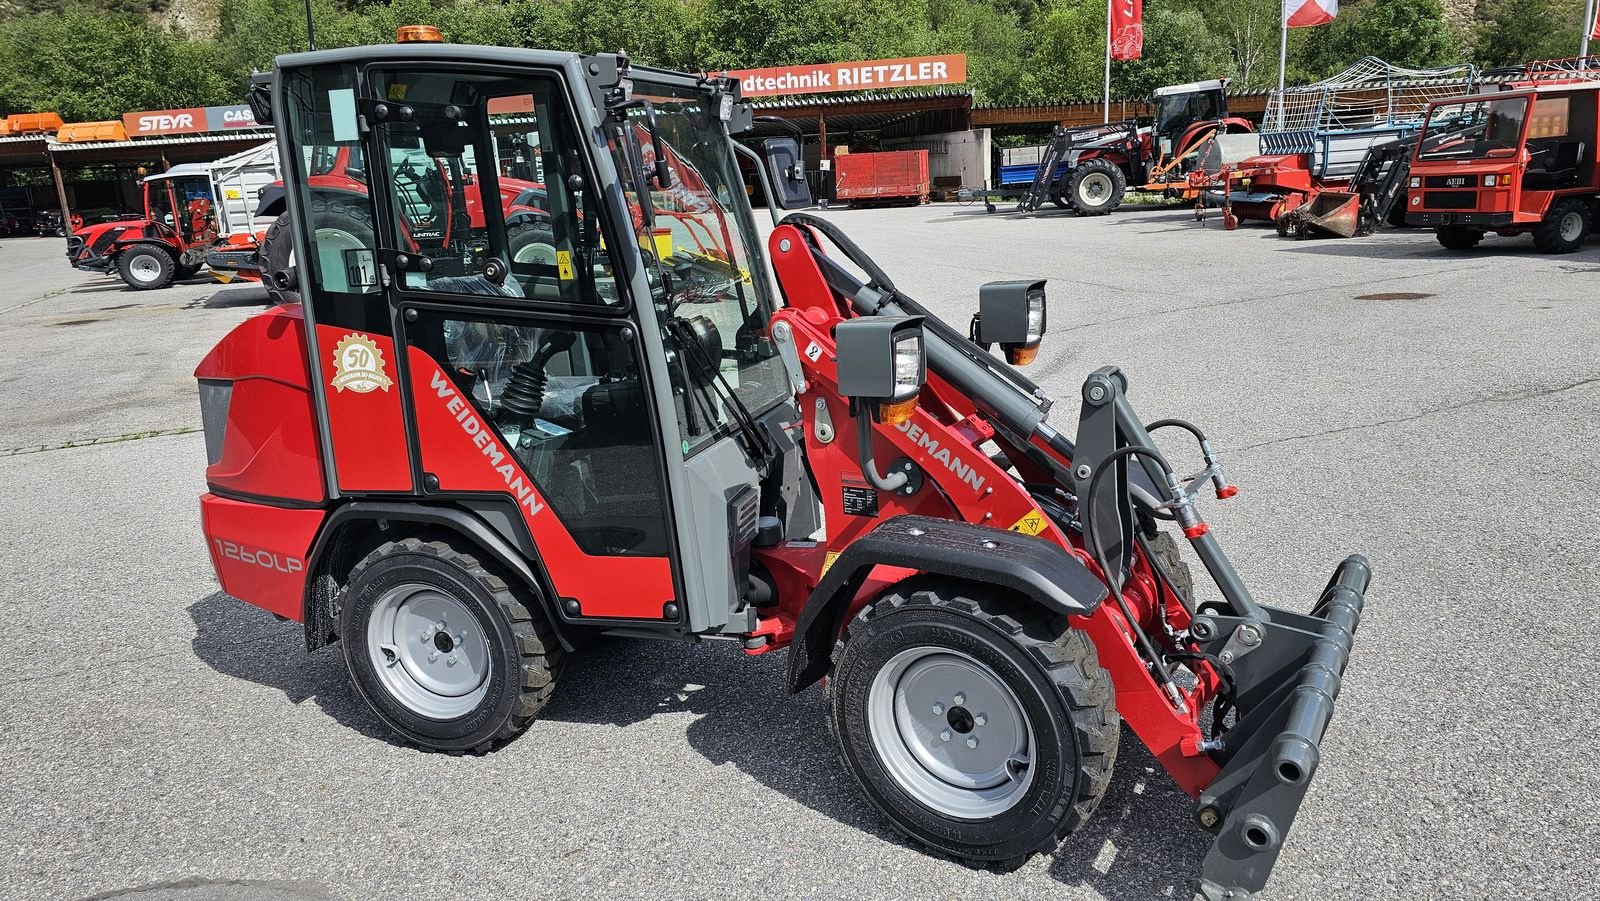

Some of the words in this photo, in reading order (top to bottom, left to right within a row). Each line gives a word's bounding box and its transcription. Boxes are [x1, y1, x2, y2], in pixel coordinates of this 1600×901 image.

[740, 69, 831, 93] dtechnik
[837, 61, 948, 86] RIETZLER
[138, 113, 193, 132] STEYR
[1446, 177, 1465, 186] AEBI
[350, 265, 368, 284] 101
[348, 348, 369, 368] 50
[430, 369, 545, 516] WEIDEMANN
[894, 418, 985, 491] DEMANN
[215, 538, 303, 575] 1260LP
